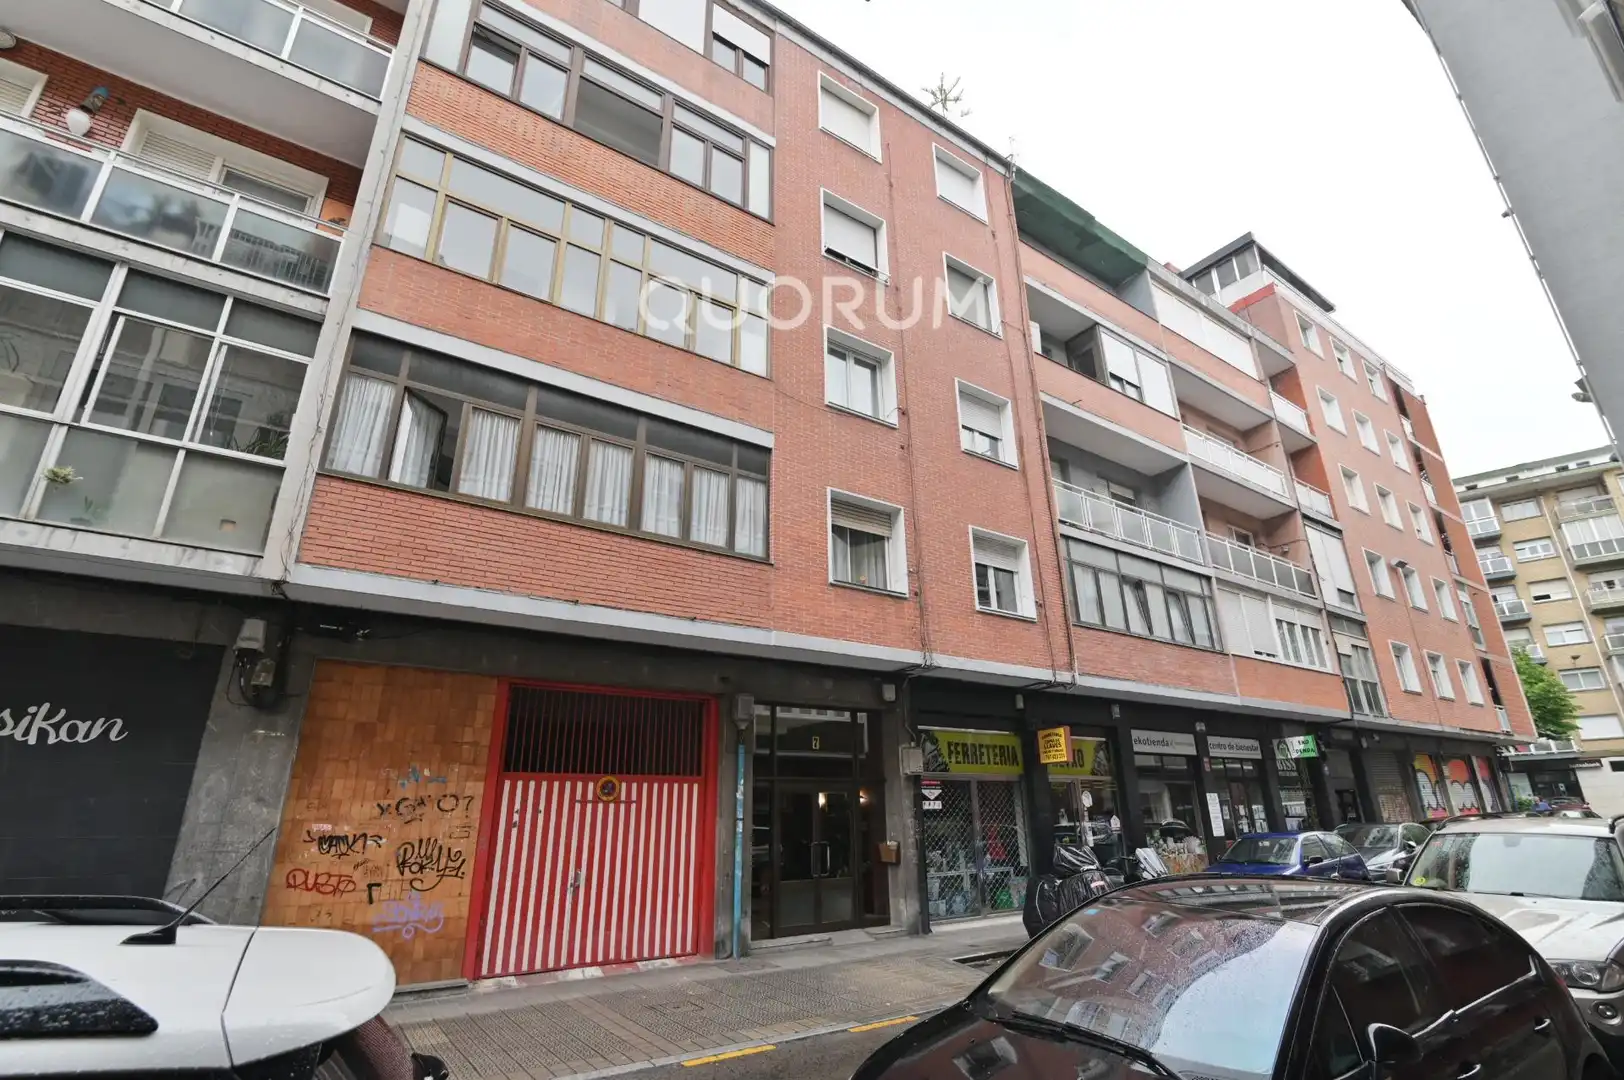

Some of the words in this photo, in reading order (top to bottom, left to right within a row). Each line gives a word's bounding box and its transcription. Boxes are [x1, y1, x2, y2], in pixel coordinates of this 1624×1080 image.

[1133, 736, 1169, 747] ekotienda
[1209, 742, 1227, 750] centro
[1227, 742, 1235, 751] de
[947, 741, 1019, 767] FERRETERIA
